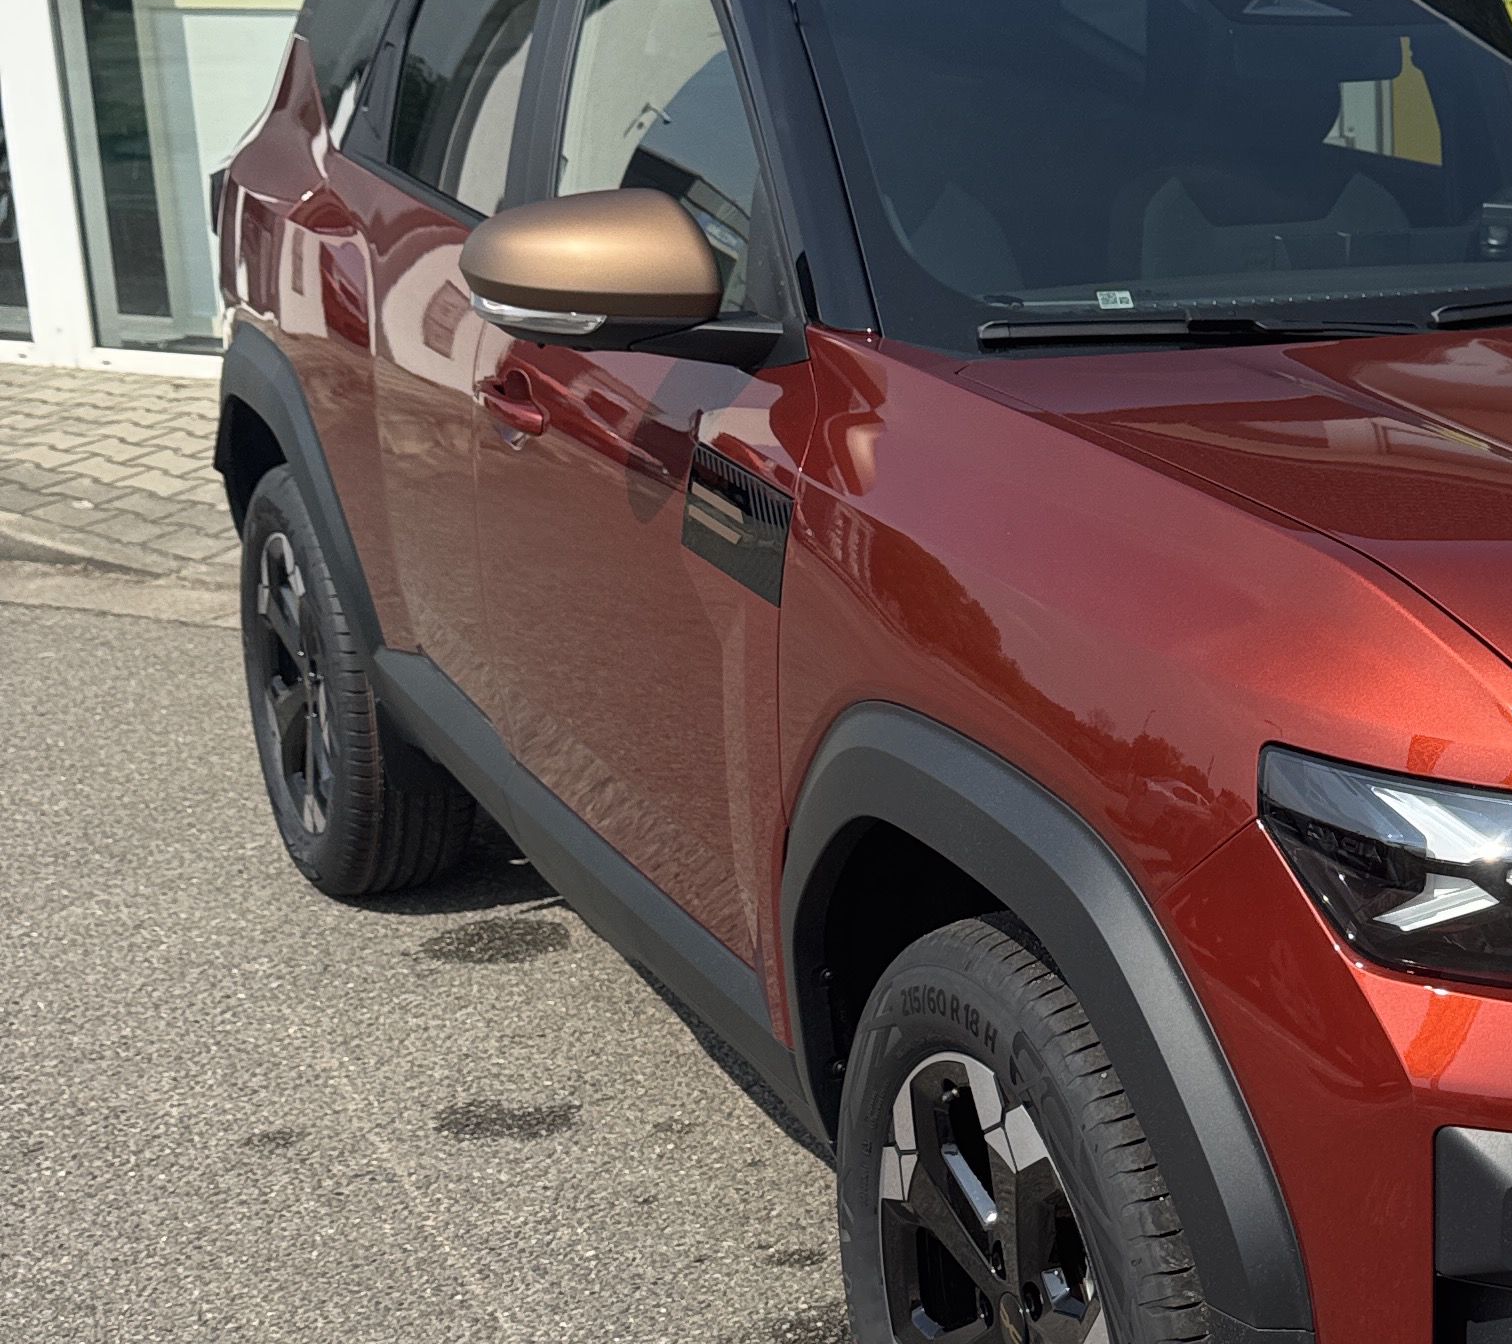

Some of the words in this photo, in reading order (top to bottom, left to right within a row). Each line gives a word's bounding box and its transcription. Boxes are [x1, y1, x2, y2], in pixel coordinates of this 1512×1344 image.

[900, 984, 947, 1018] 215/60
[950, 994, 961, 1025] R
[963, 1003, 980, 1038] 18
[983, 1020, 999, 1054] H
